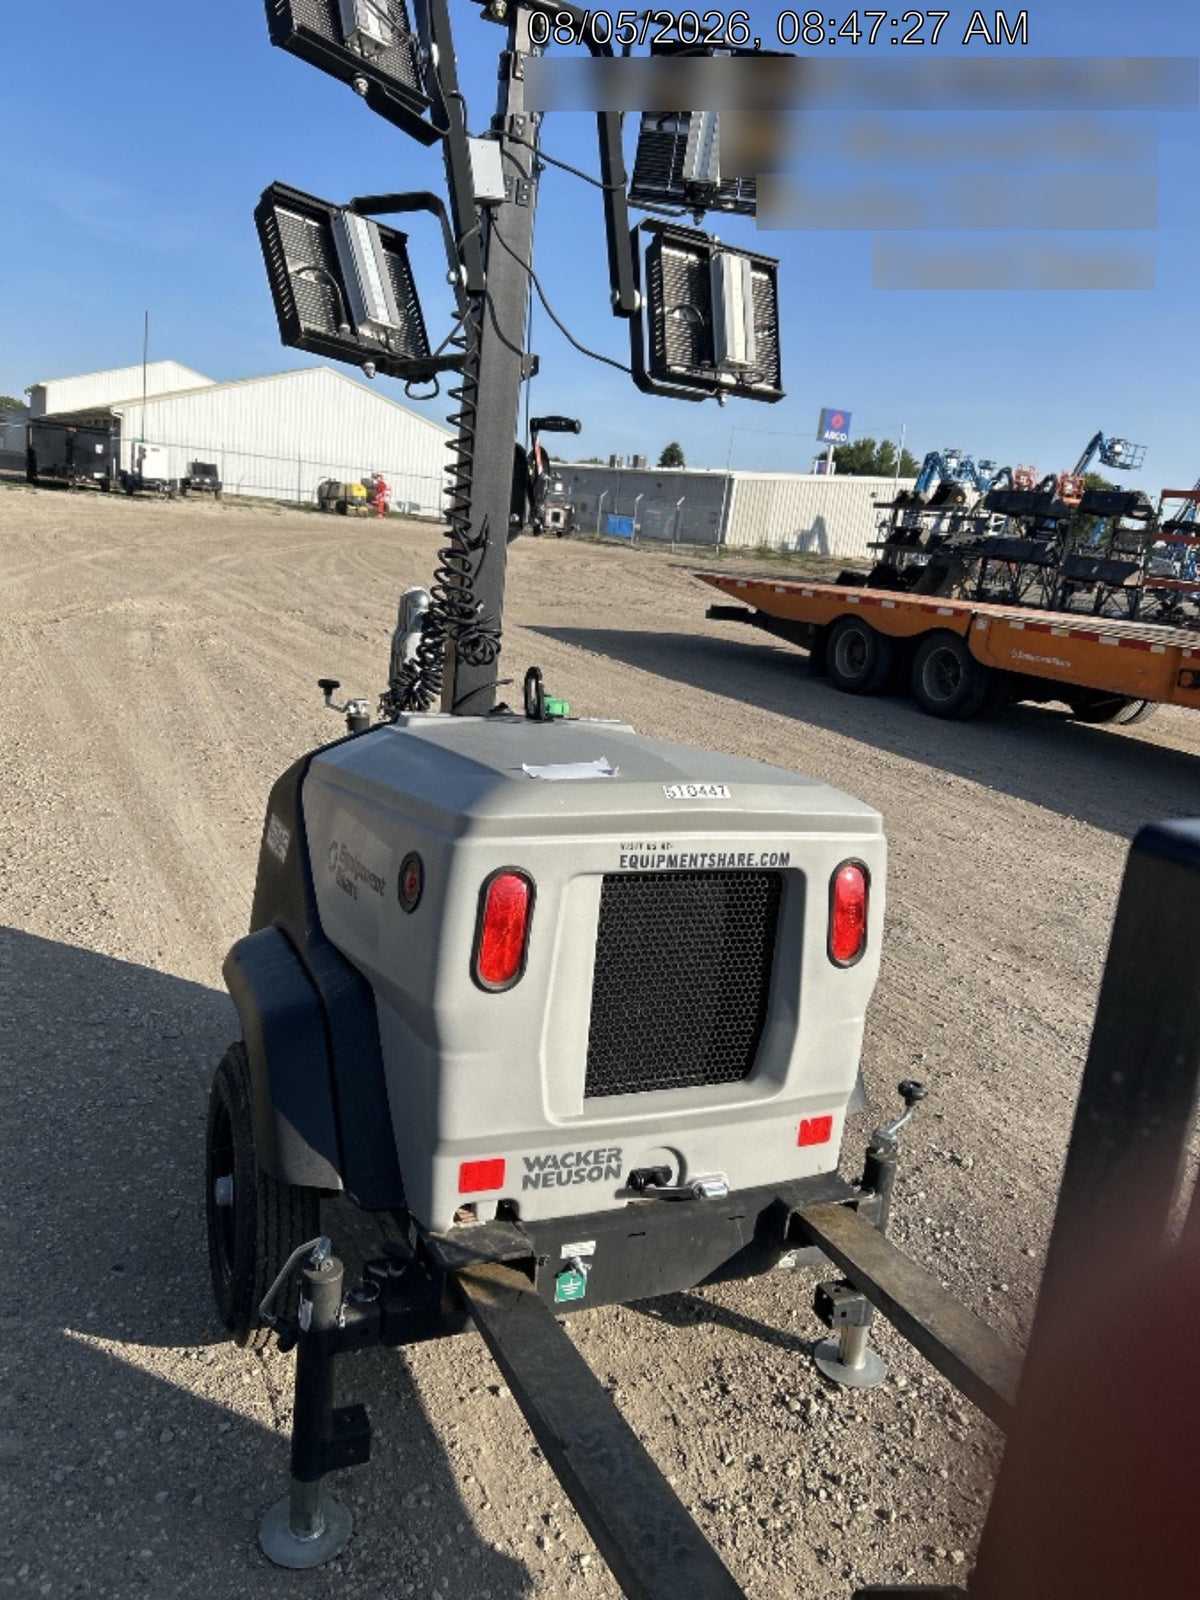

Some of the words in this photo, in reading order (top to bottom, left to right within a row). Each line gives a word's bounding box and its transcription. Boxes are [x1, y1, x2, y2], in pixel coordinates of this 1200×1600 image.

[823, 430, 848, 442] ARCO
[665, 785, 726, 799] 510447
[619, 853, 790, 869] EQUIPMENTSHARE.COM
[522, 1148, 623, 1173] WACKER
[522, 1164, 622, 1191] NEUSON
